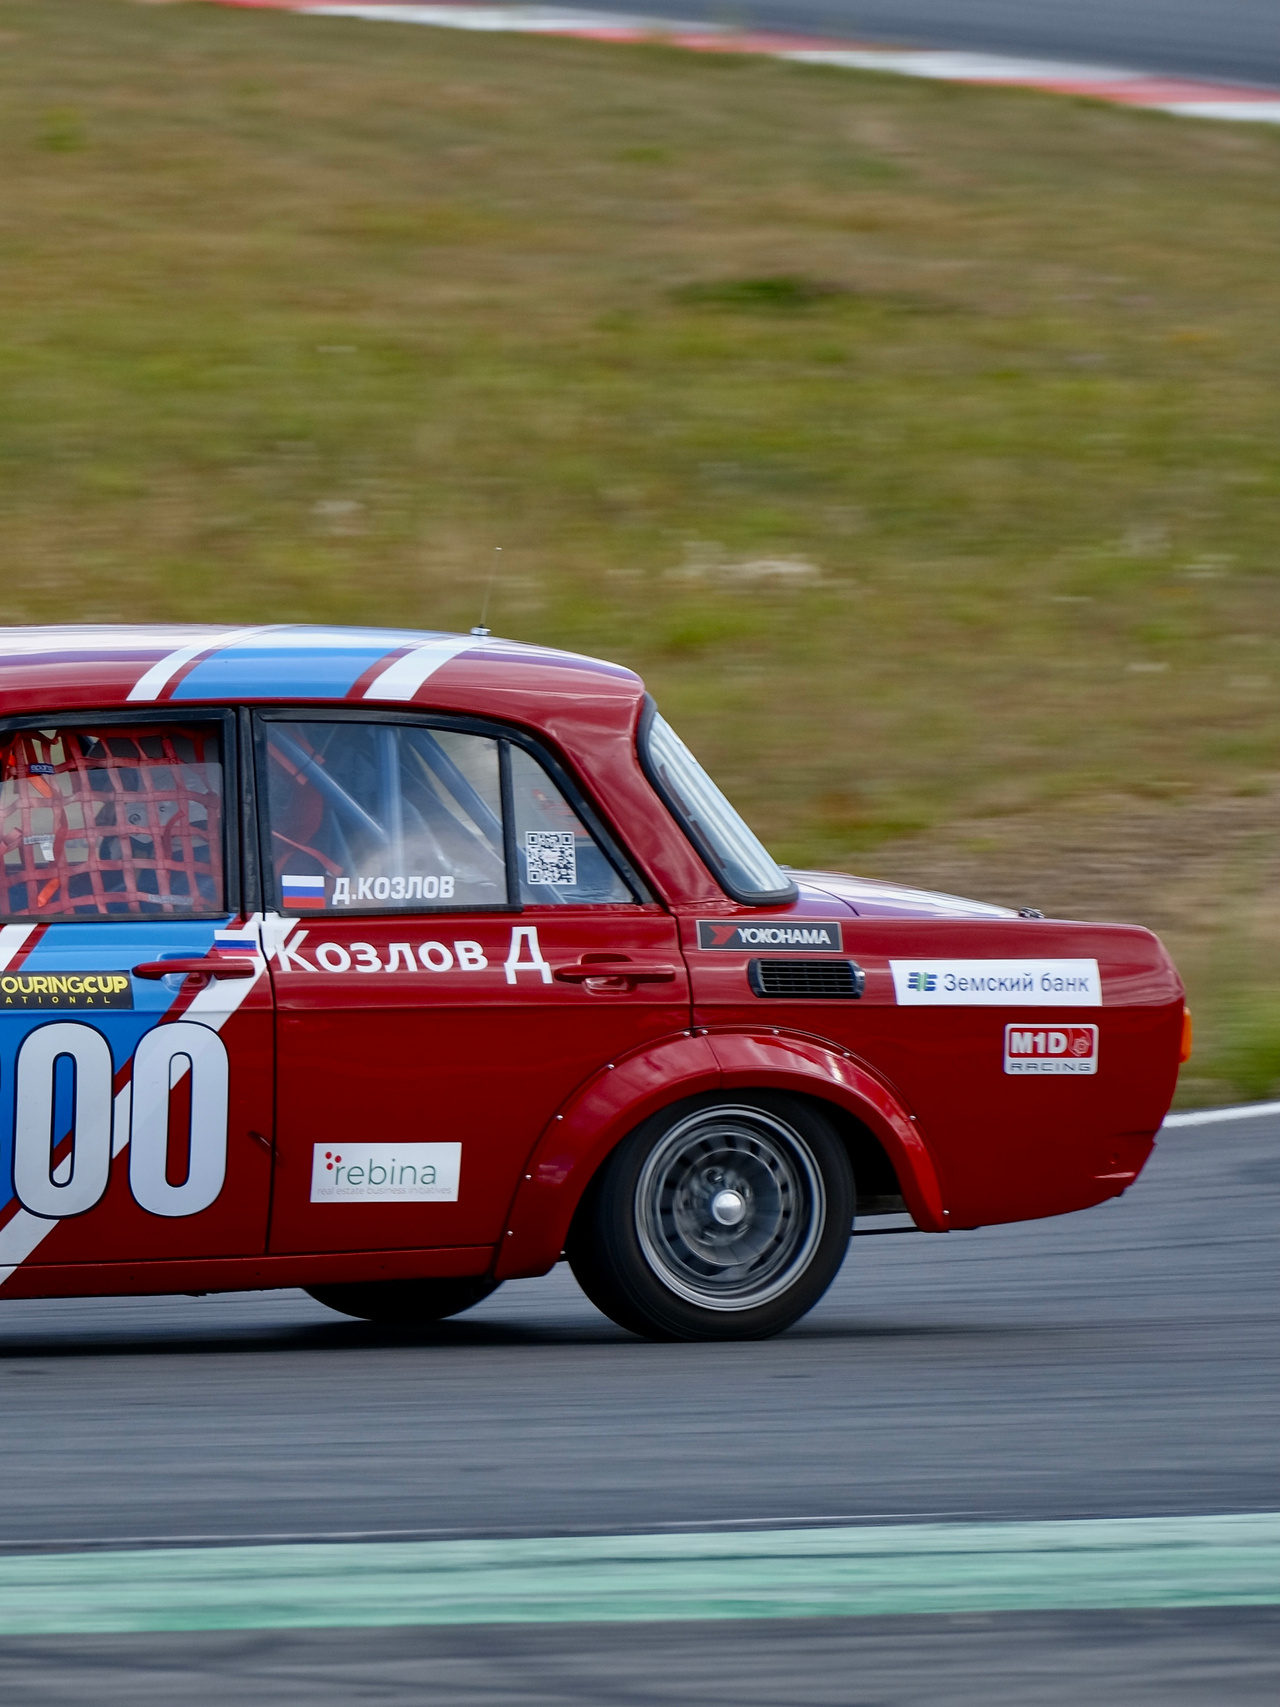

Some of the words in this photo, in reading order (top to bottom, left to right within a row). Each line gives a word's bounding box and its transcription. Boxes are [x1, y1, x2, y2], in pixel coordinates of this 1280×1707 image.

[331, 875, 455, 905] Д.КОЗЛОВ
[737, 928, 832, 945] YOKOHAMA
[275, 929, 489, 974] Козлов
[503, 925, 554, 985] Д
[943, 972, 1034, 992] Земский
[1040, 972, 1090, 992] банк
[1010, 1031, 1068, 1054] M1D
[1010, 1062, 1092, 1072] RACING
[335, 1158, 437, 1186] rebina
[317, 1186, 335, 1196] real
[336, 1186, 365, 1196] estate
[366, 1186, 407, 1195] business
[408, 1186, 452, 1195] initiatives
